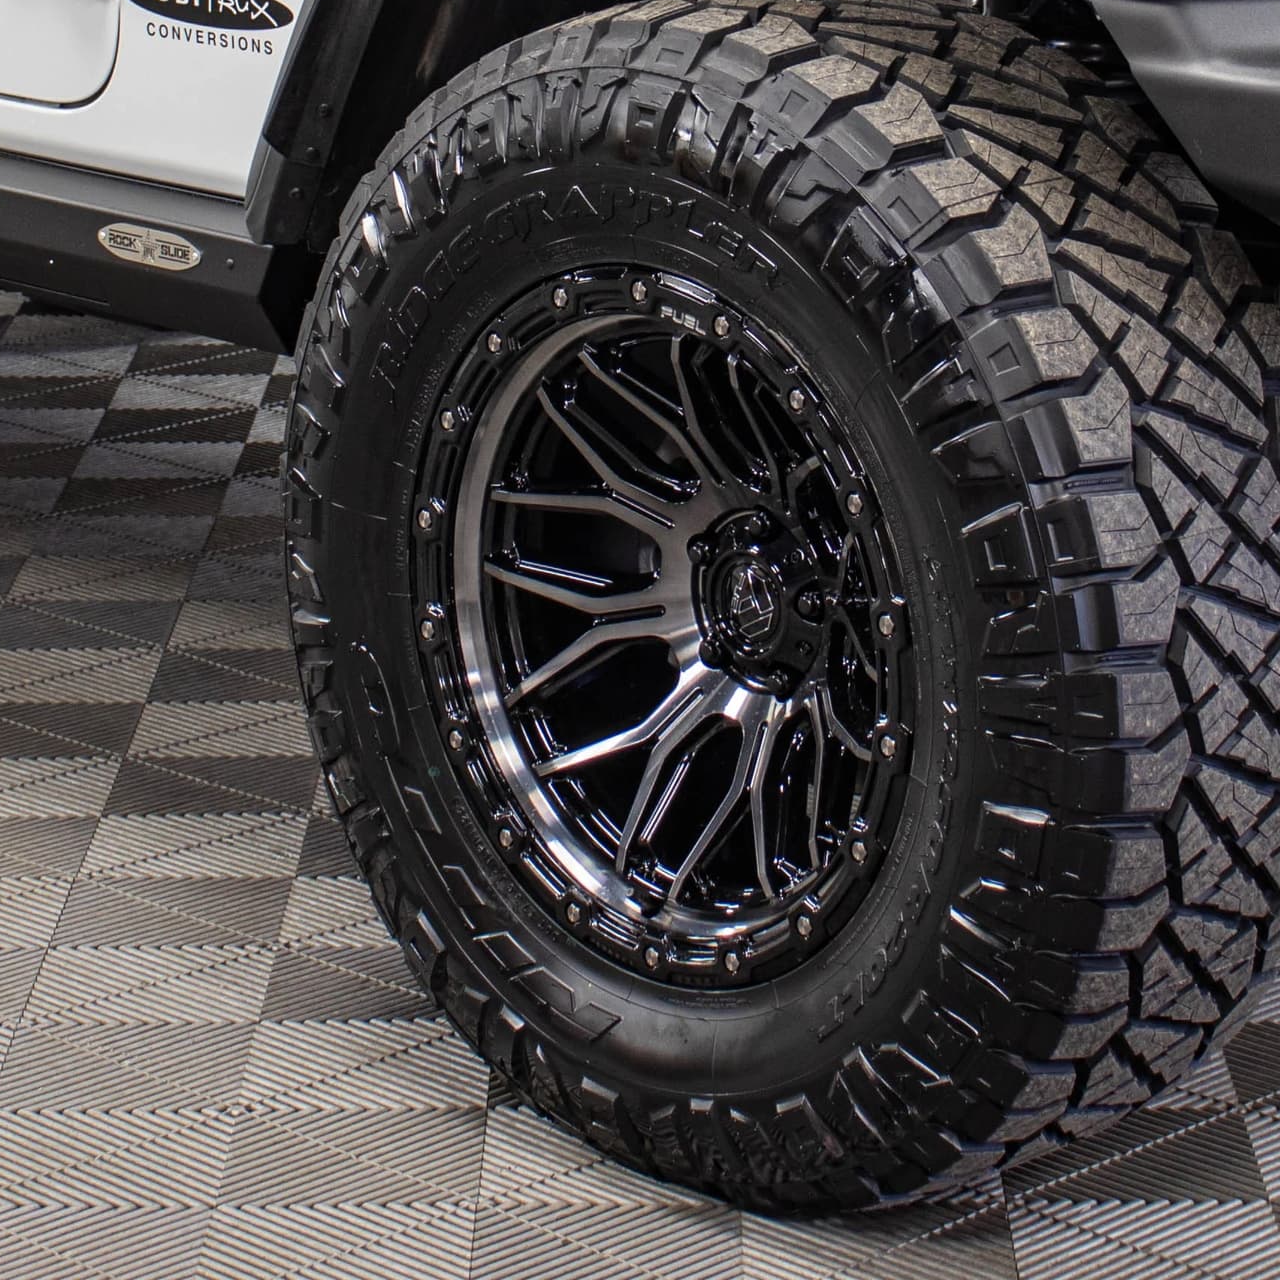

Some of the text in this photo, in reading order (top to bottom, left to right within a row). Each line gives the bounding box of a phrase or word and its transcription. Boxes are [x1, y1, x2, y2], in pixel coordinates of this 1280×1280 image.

[147, 22, 273, 55] CONVERSIONS
[108, 232, 190, 261] ROCK SLIDE
